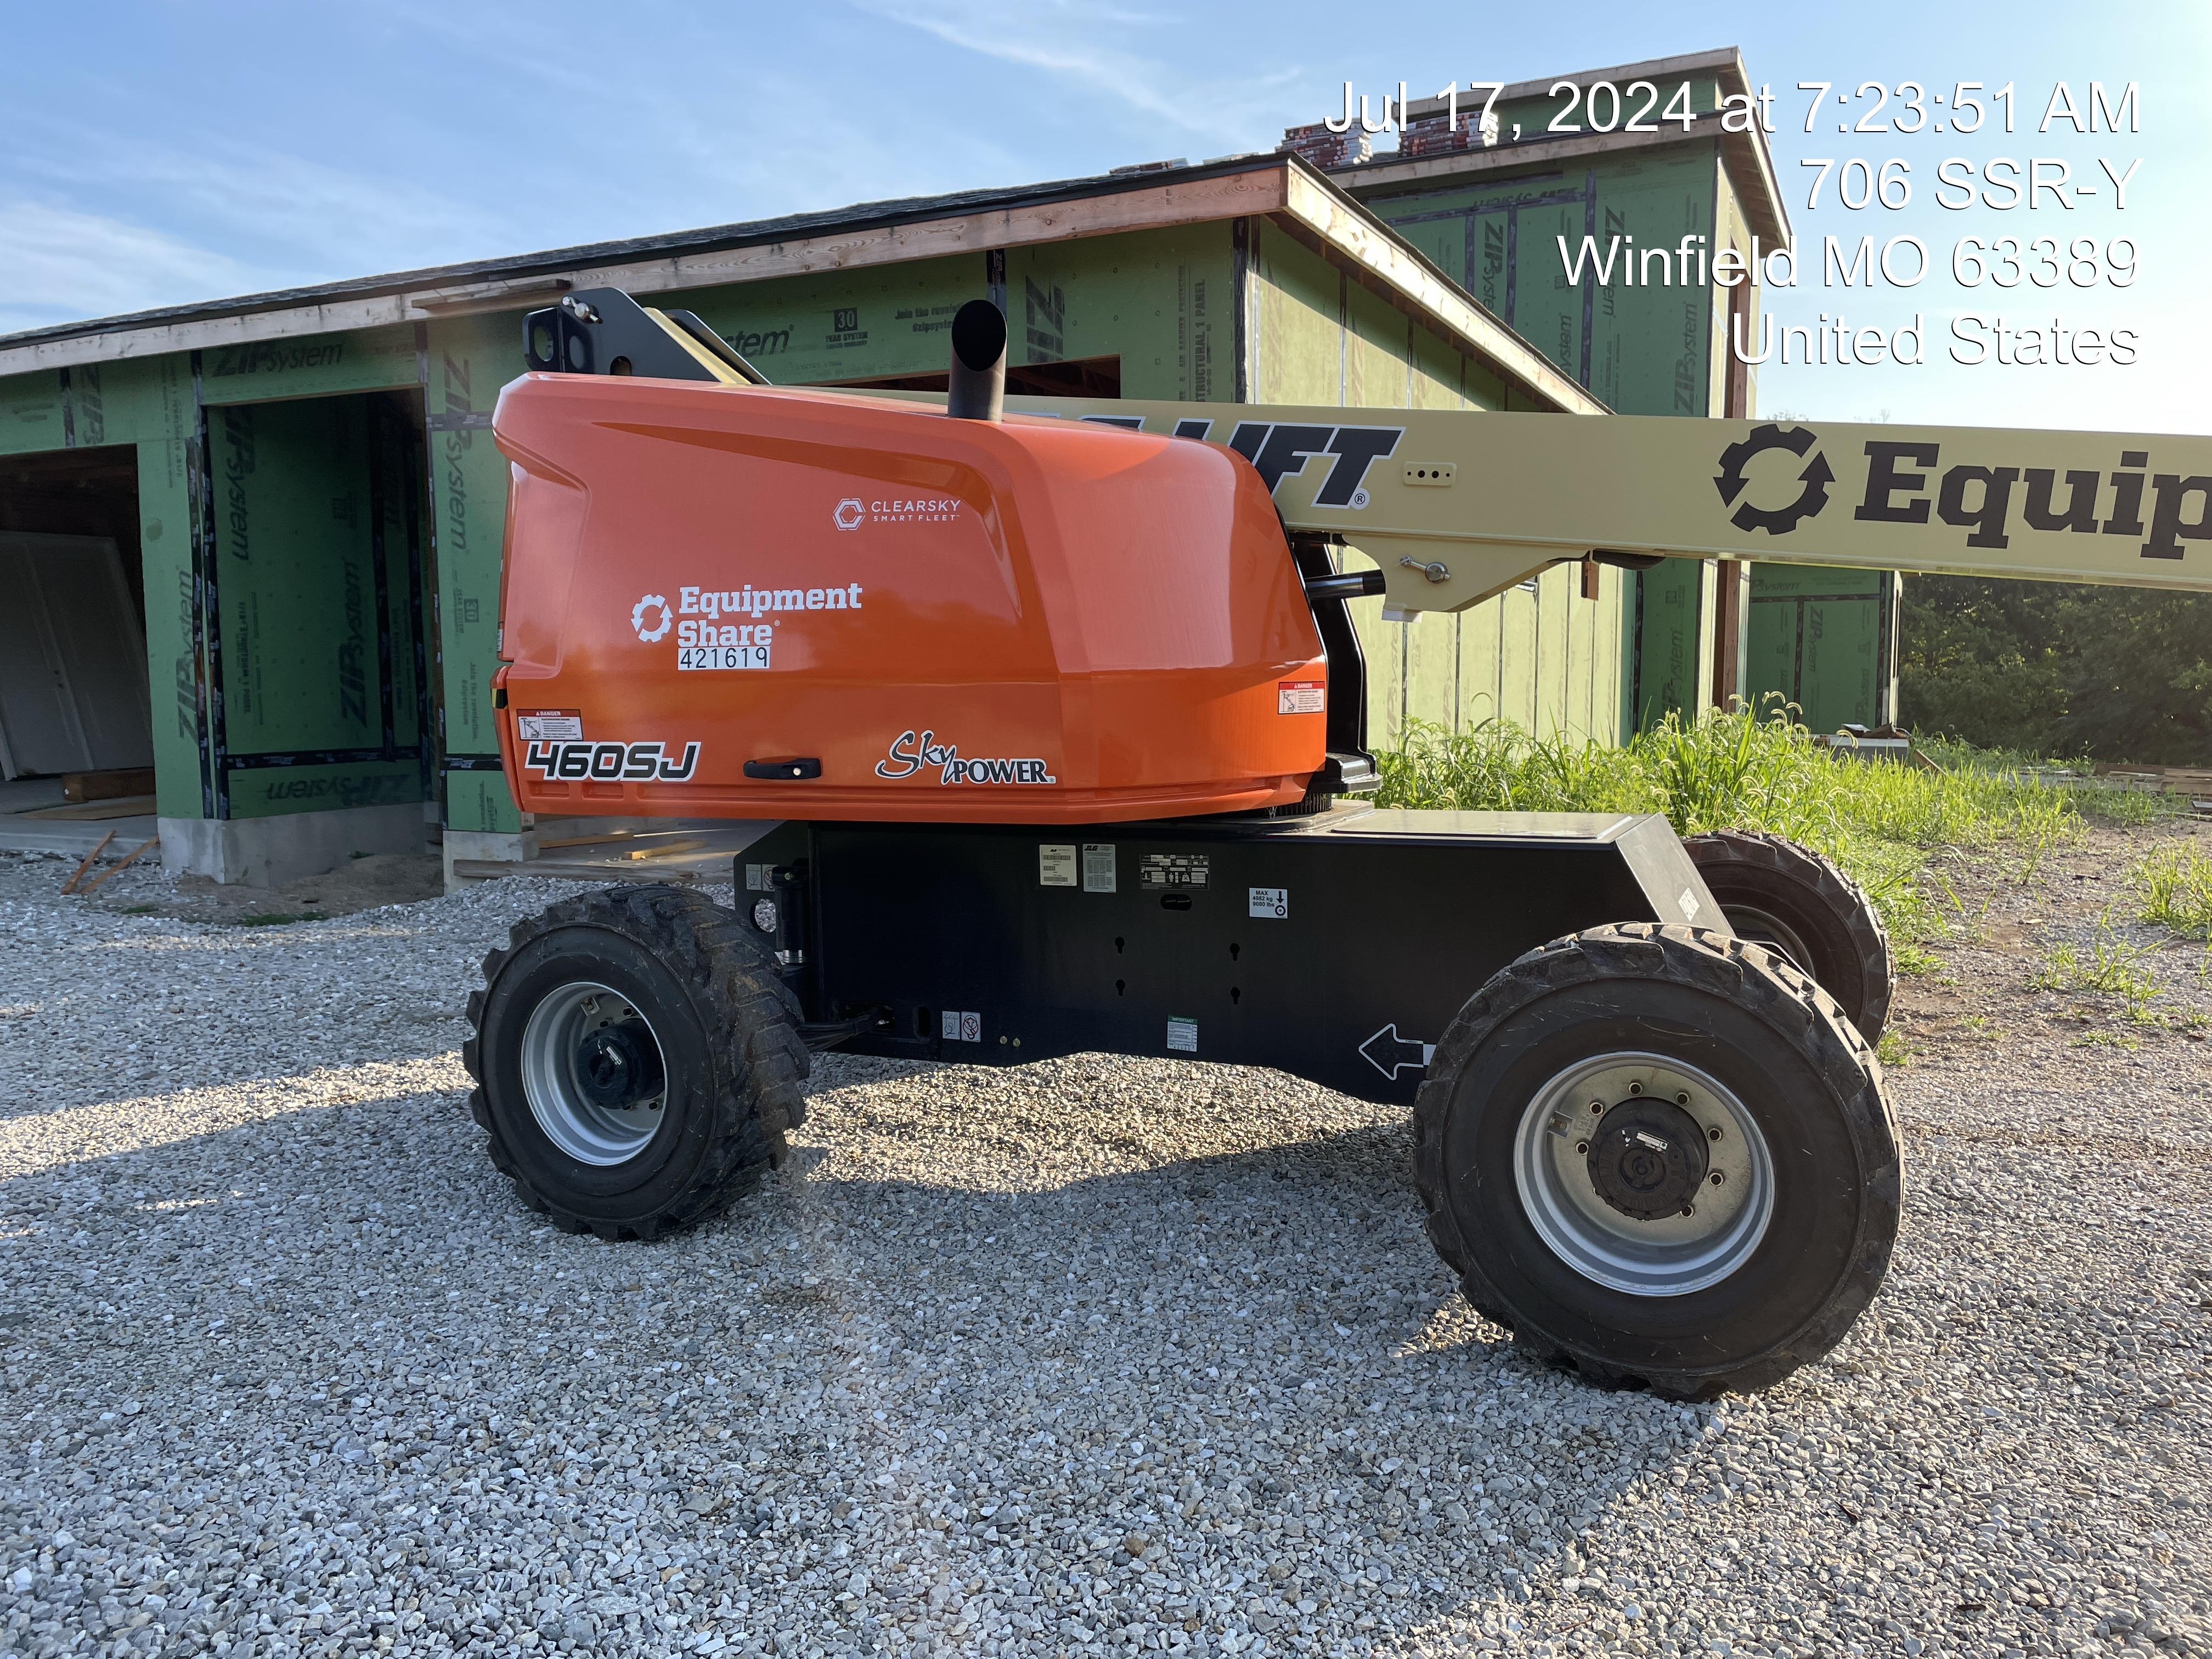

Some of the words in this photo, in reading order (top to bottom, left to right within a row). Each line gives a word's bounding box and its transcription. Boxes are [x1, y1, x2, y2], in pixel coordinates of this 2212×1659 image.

[1195, 279, 1206, 317] PANEL
[871, 500, 961, 512] CLEARSKY
[678, 583, 863, 619] Equipment
[678, 619, 772, 647] Share
[680, 647, 768, 669] 421619
[526, 743, 699, 780] 460SJ
